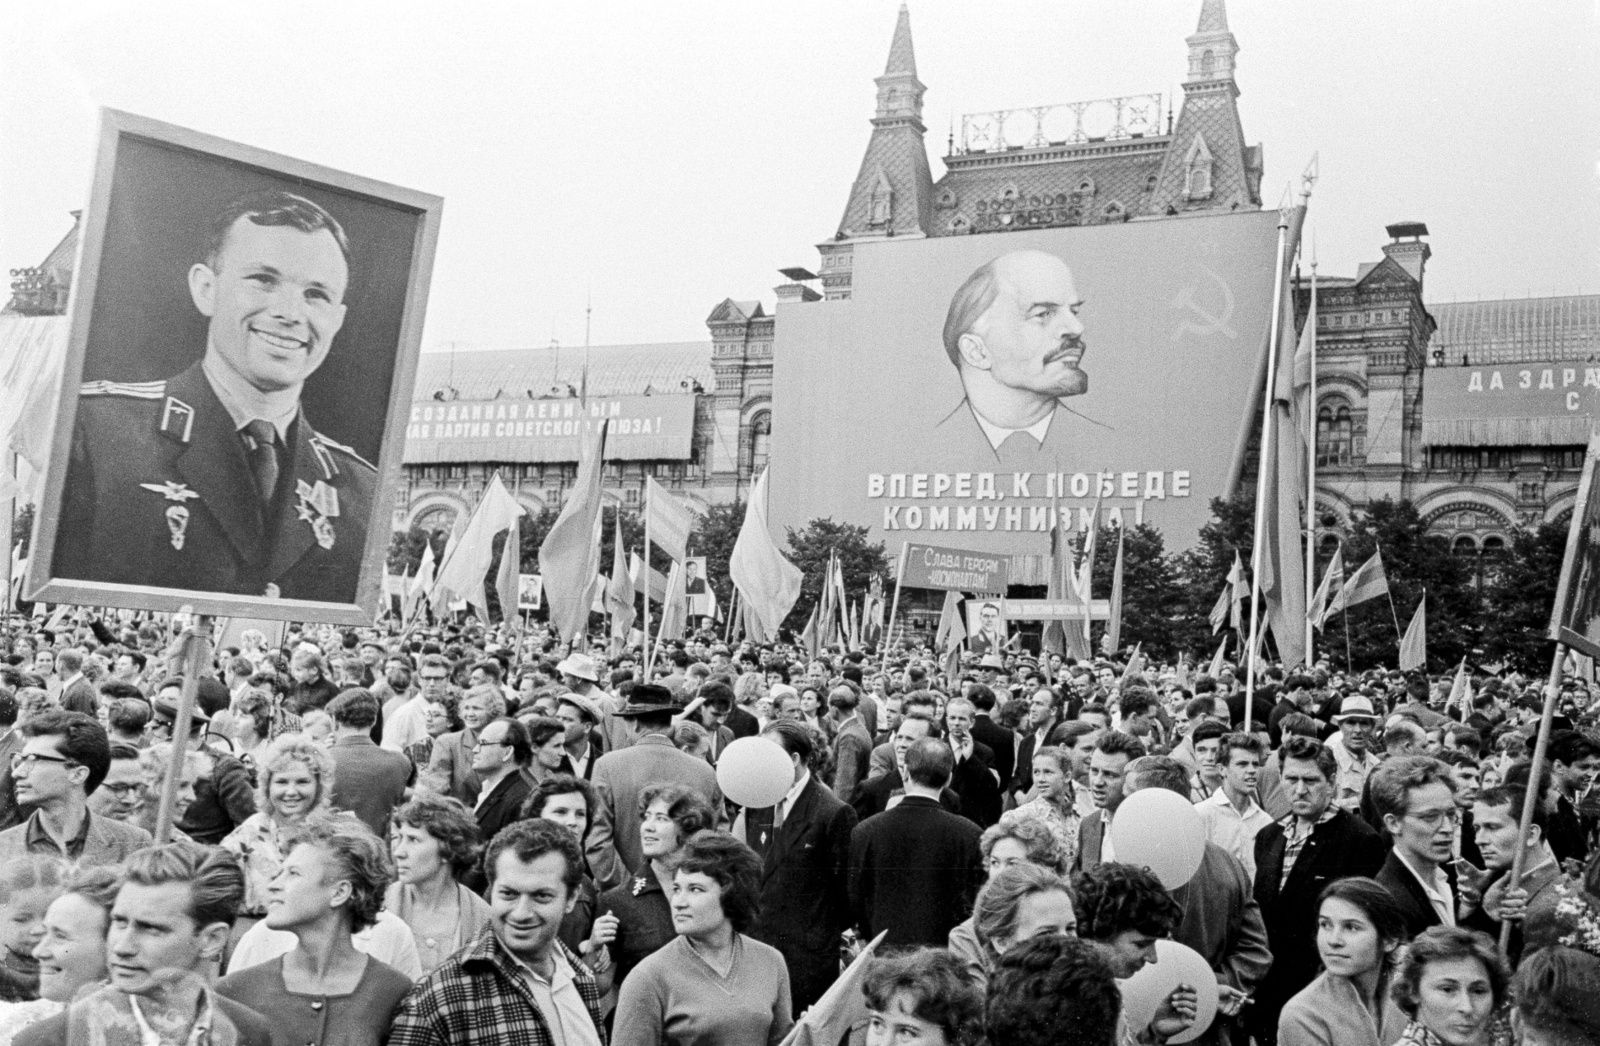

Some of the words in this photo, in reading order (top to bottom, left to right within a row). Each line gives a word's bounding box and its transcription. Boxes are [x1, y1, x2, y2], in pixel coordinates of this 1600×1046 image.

[1467, 371, 1504, 393] ДА
[411, 403, 519, 422] СОЗДАННАЯ
[525, 401, 621, 419] ЛЕНИЫМ
[434, 422, 491, 439] ПАРТИЯ
[868, 472, 1005, 501] ВПЕРЕД,
[1013, 472, 1032, 498] К
[1046, 470, 1191, 501] ПОБЕДЕ
